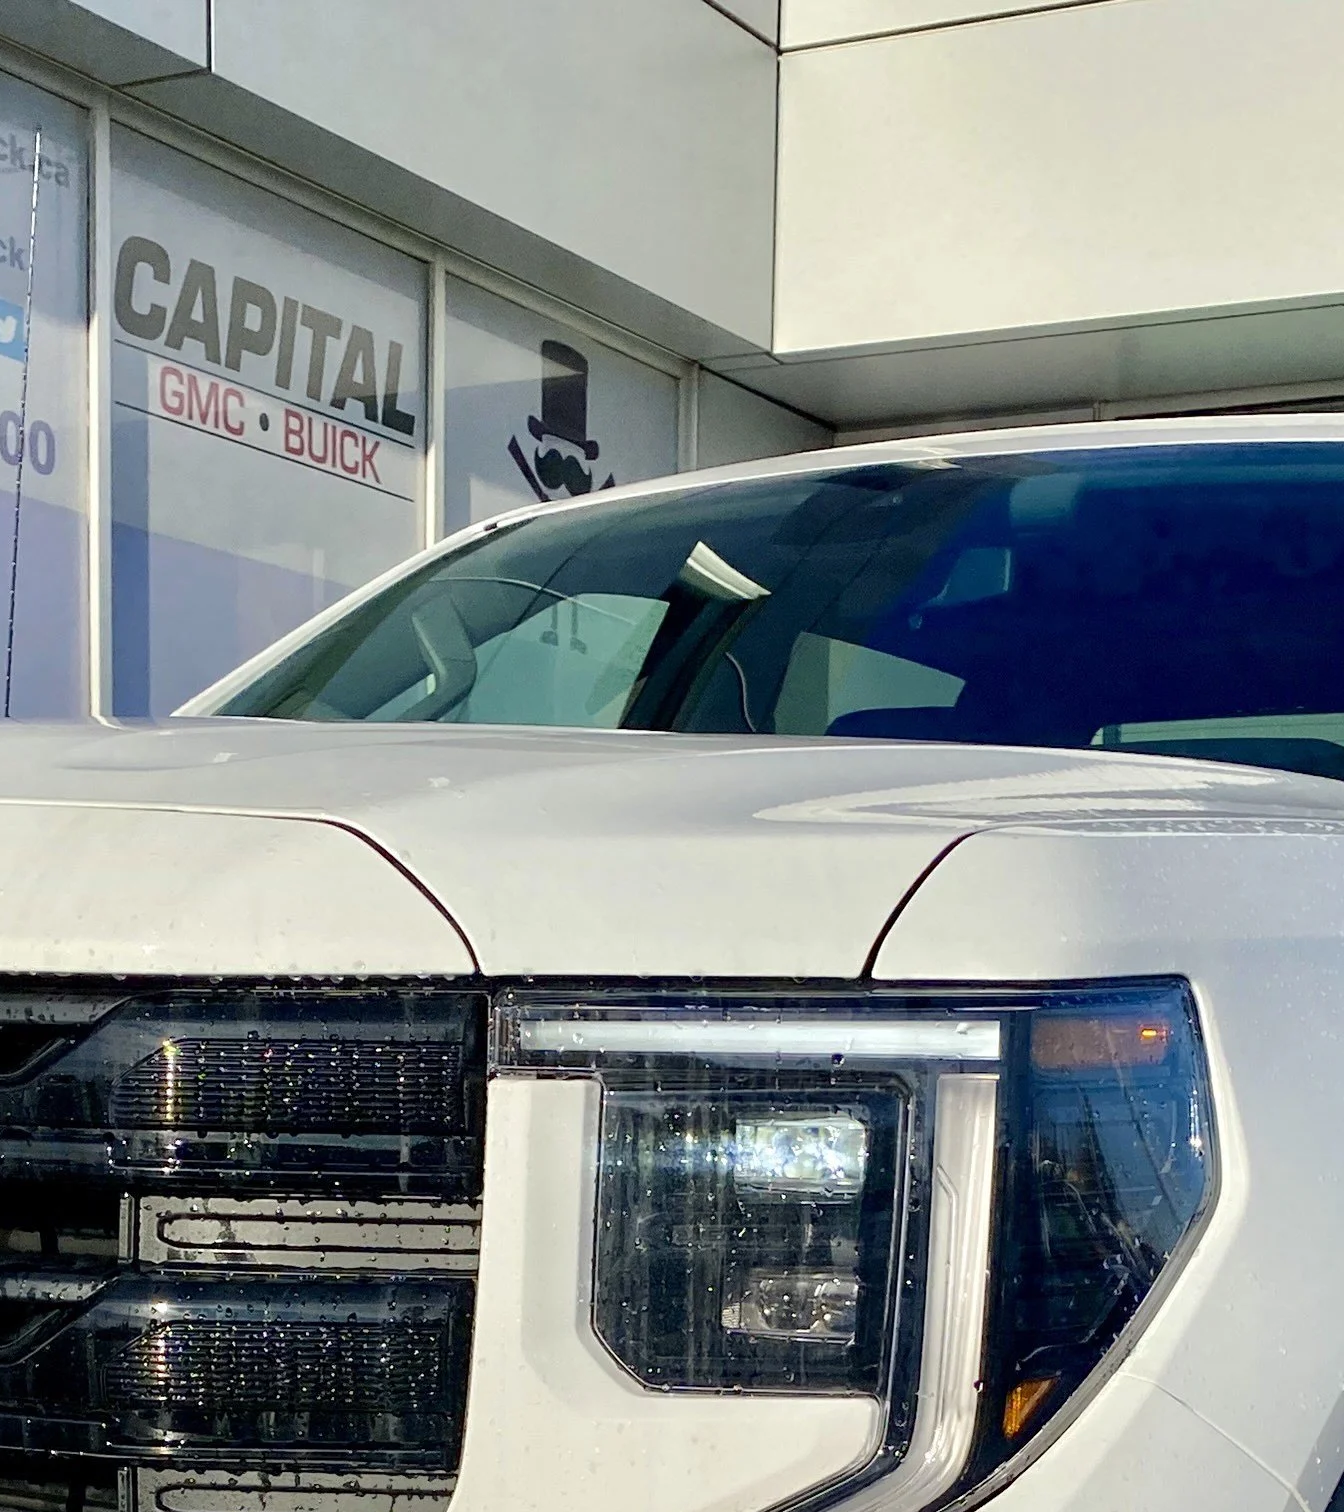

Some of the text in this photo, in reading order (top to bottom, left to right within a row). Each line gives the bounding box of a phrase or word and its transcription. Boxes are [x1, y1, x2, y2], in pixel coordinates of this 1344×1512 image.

[113, 235, 416, 436] CAPITAL
[159, 365, 381, 486] GMC BUICK
